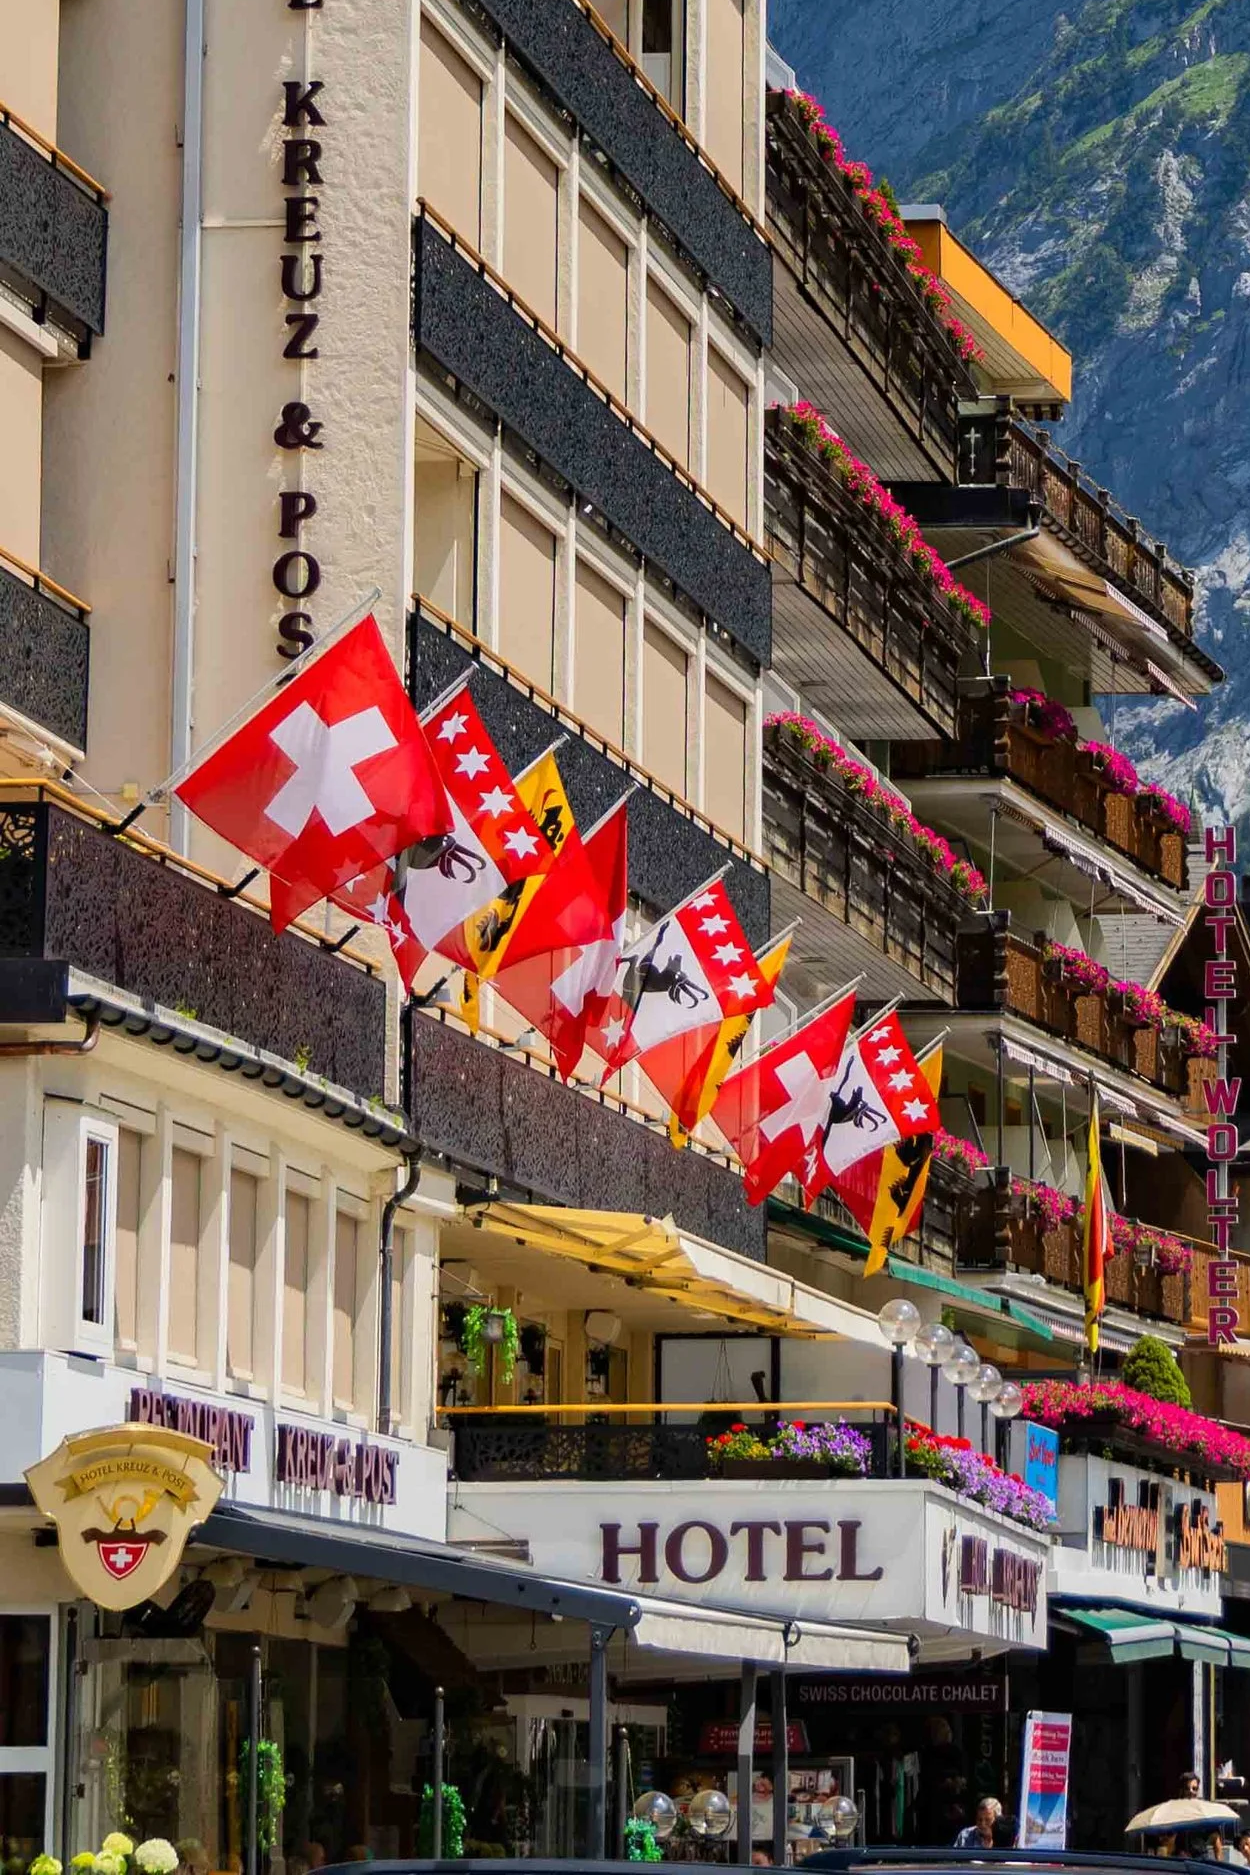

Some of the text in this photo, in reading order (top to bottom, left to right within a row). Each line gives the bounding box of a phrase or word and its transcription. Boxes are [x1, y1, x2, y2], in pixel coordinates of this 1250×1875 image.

[282, 80, 327, 360] KREUZ
[273, 401, 324, 450] &
[272, 491, 323, 667] POS
[1203, 826, 1241, 1346] HOTEL WOLTER
[80, 1465, 116, 1483] HOTEL
[116, 1462, 151, 1473] KREUZ
[161, 1469, 186, 1489] POST
[277, 1425, 334, 1493] KREUZ
[355, 1443, 399, 1506] POST
[600, 1520, 884, 1584] HOTEL
[799, 1684, 999, 1702] SWISS CHOCOLATE CHALET
